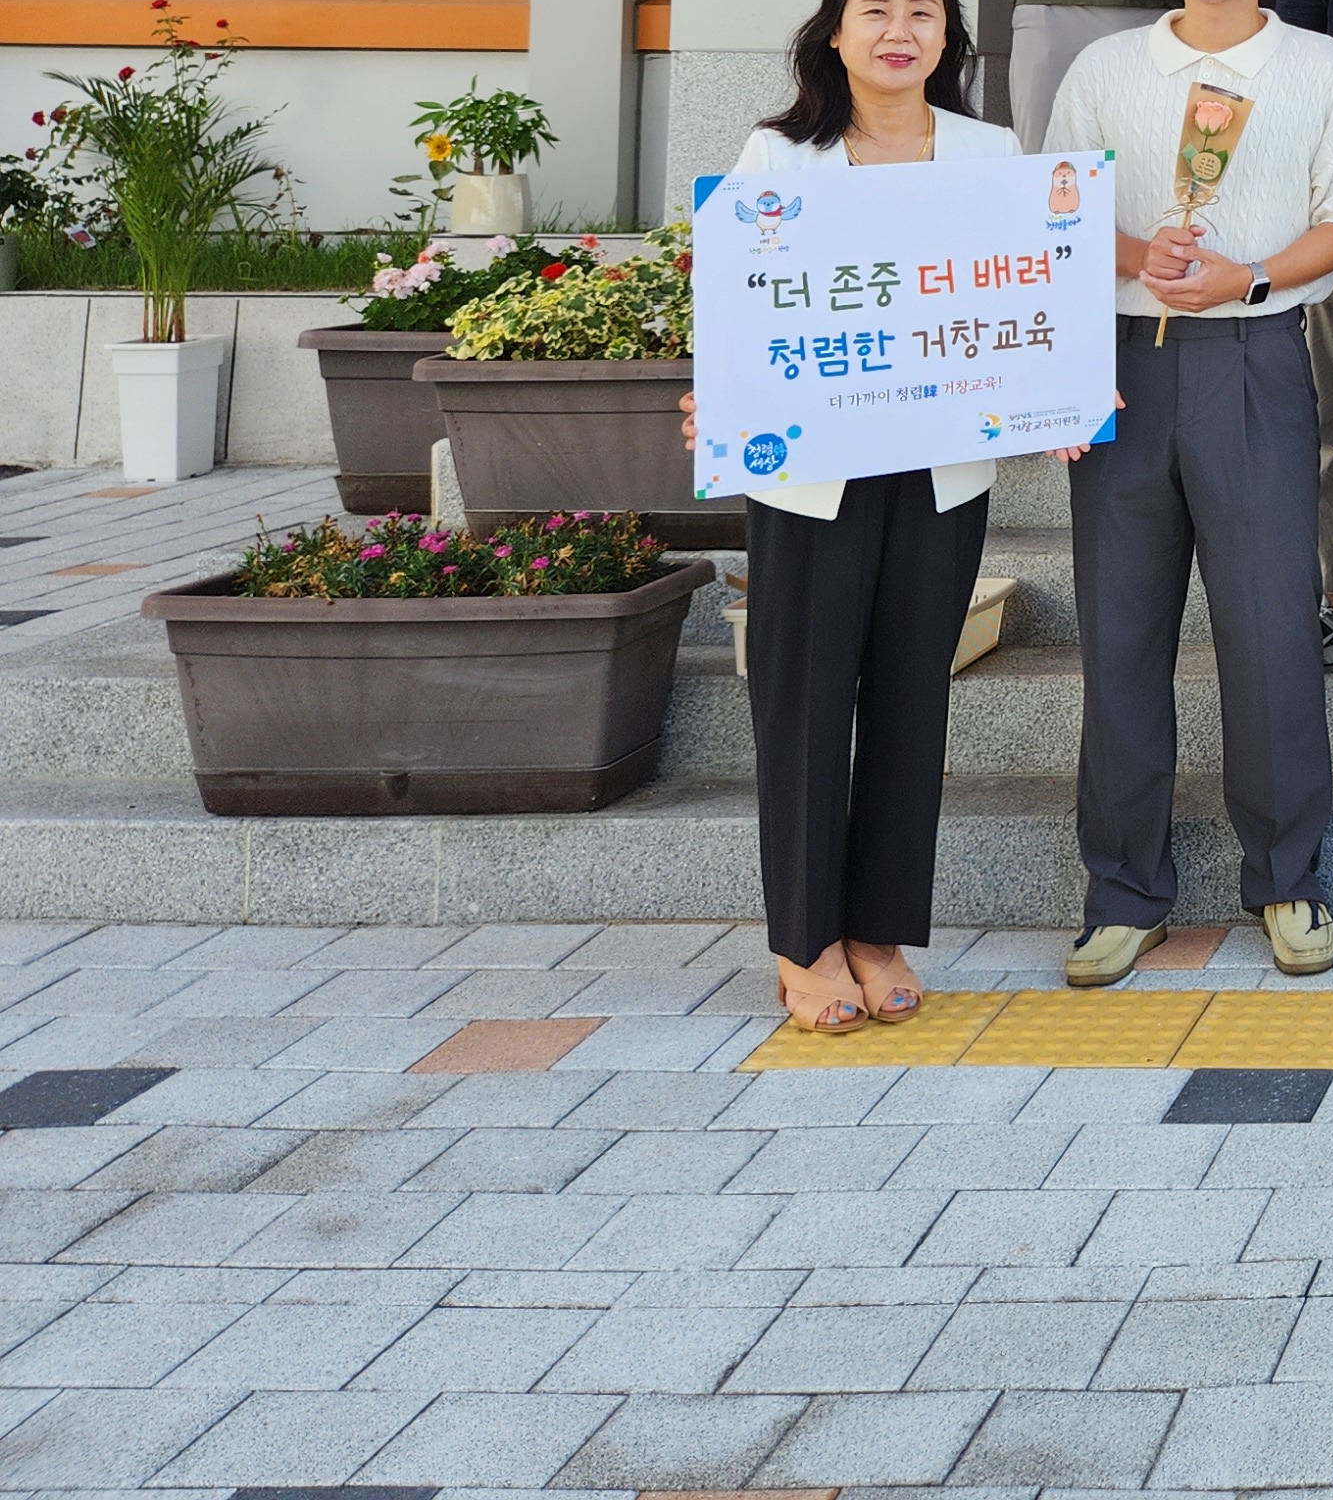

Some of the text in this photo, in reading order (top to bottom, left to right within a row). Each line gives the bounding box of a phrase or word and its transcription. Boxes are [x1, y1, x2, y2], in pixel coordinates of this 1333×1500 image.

[748, 245, 1072, 311] “더 존중 더 배려”
[768, 311, 1055, 380] 청렴한 거창교육
[830, 395, 841, 409] 더
[847, 389, 889, 406] 가까이
[942, 376, 1002, 395] 거창교육!
